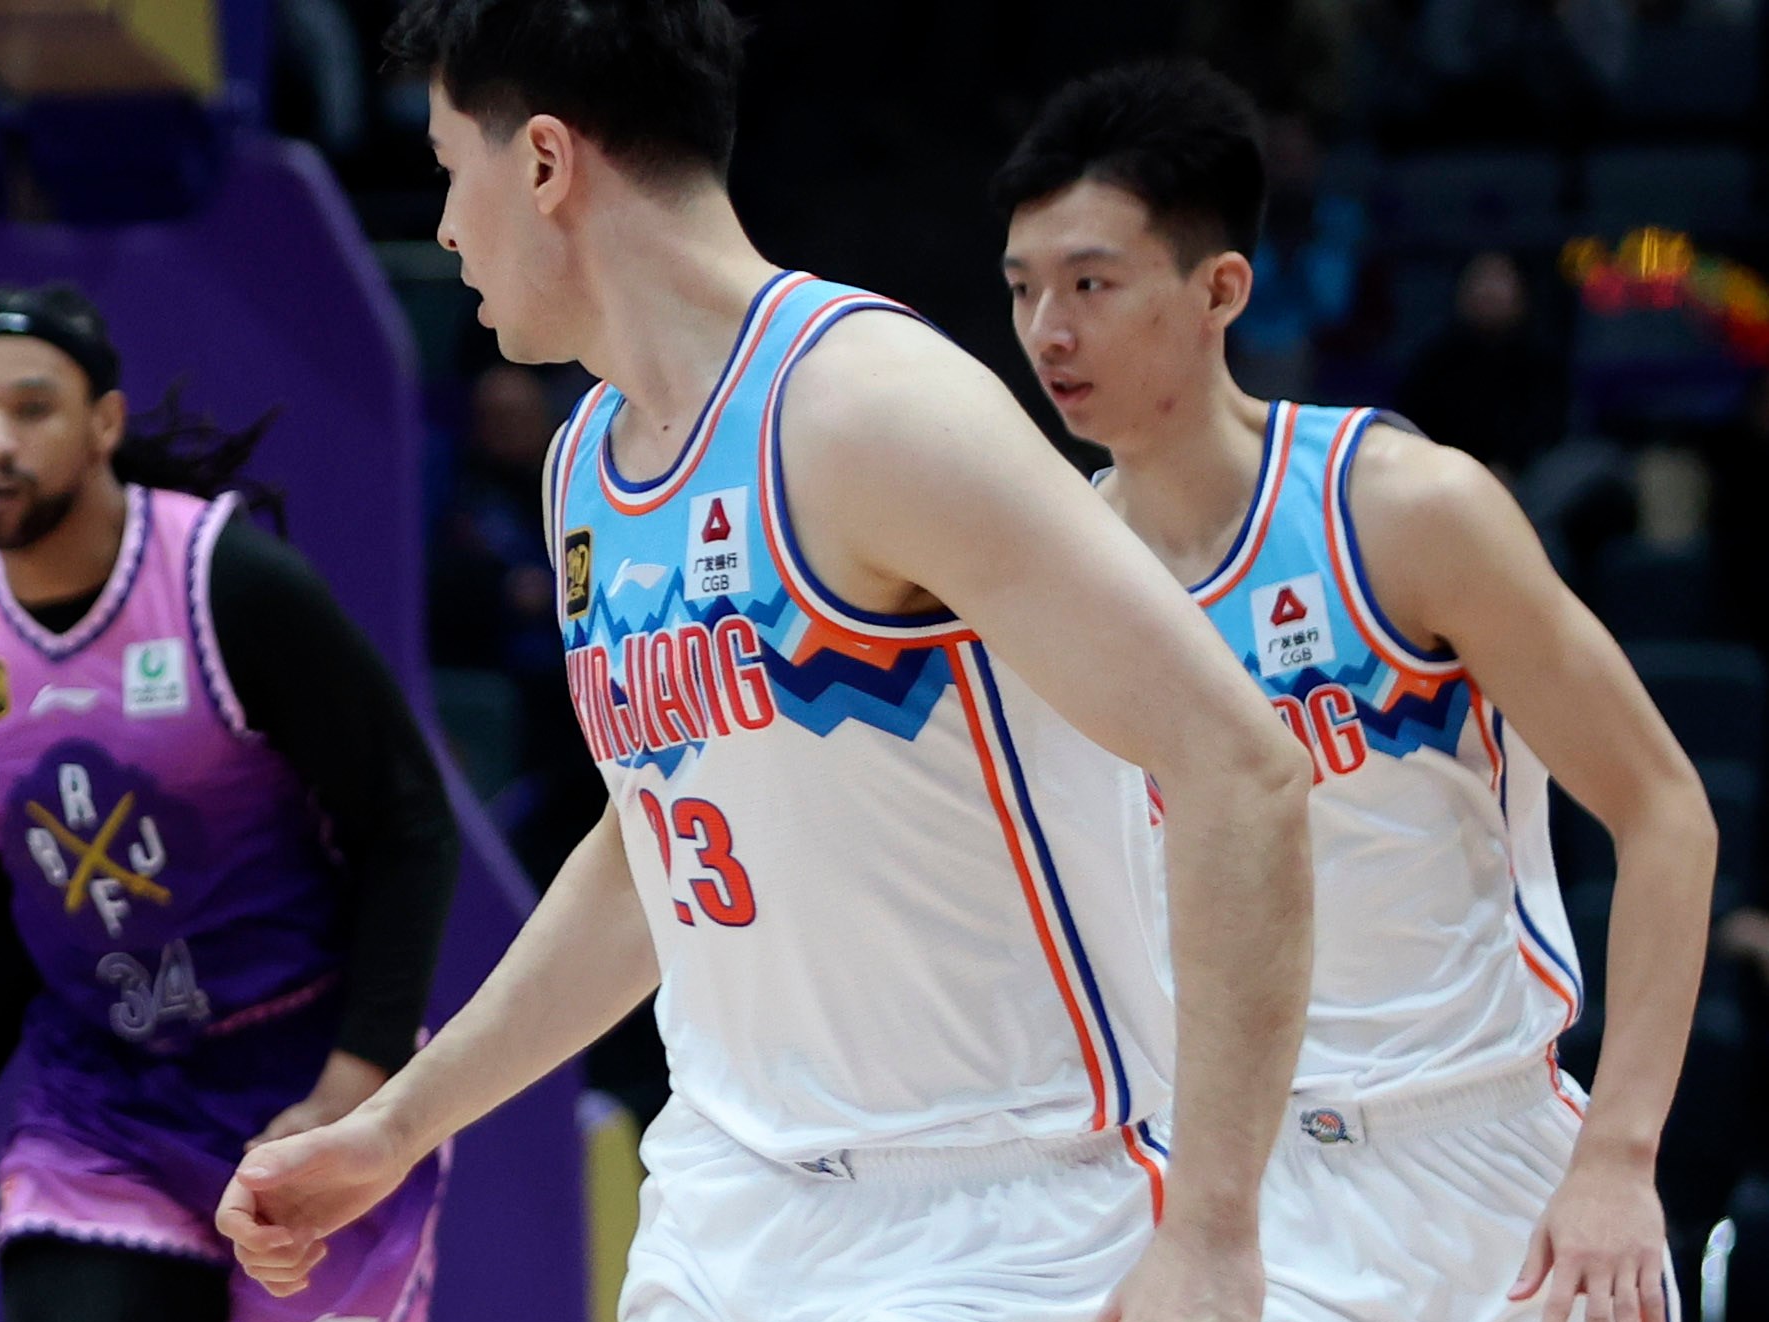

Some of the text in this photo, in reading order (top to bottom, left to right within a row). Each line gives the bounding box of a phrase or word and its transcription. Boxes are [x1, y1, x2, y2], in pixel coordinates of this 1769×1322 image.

[693, 552, 738, 574] 广发银行
[701, 574, 730, 592] CGB
[1280, 647, 1313, 666] CGB
[95, 938, 212, 1042] 34
